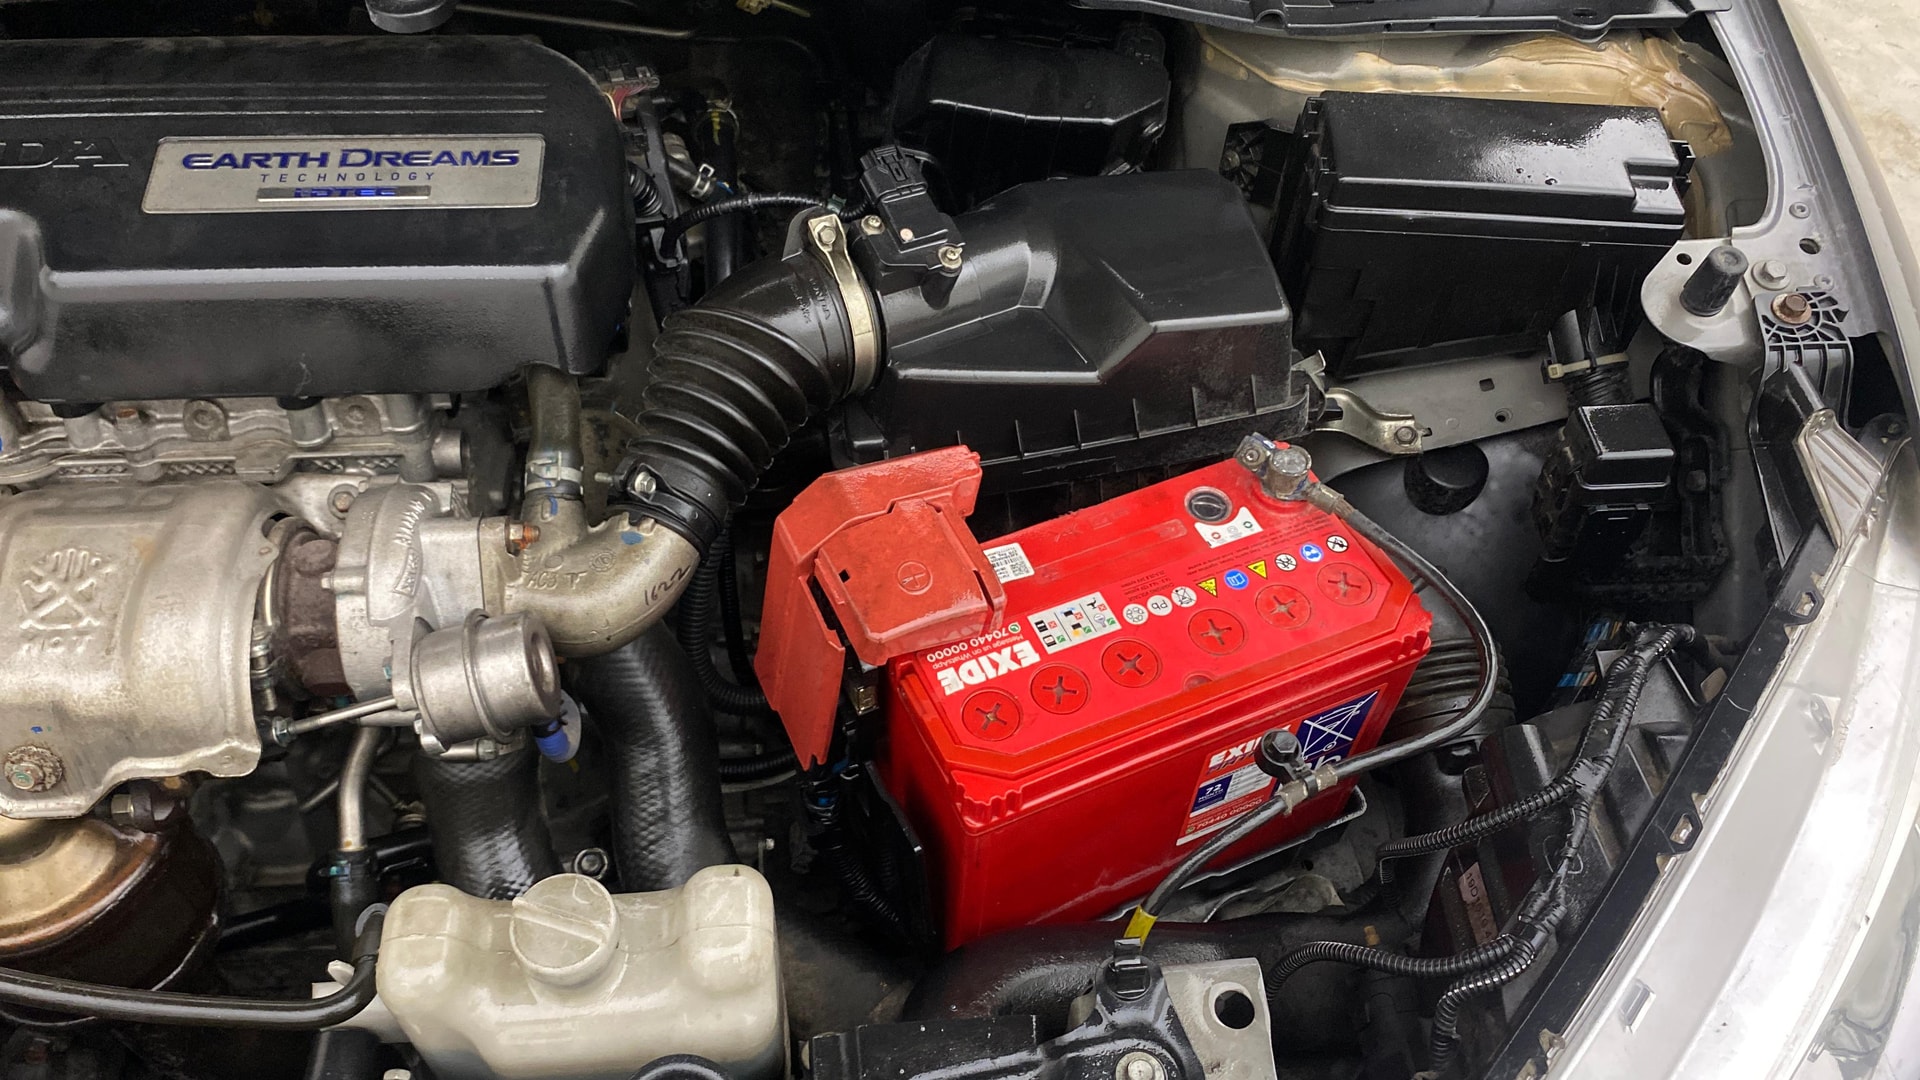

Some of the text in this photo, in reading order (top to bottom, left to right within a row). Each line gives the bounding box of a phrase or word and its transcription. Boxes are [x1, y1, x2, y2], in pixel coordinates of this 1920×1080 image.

[182, 147, 520, 170] EARTH DREAMS
[260, 171, 435, 184] TECHNOLOGY
[1151, 599, 1168, 610] Pb
[926, 627, 1009, 663] 70440 00000
[932, 652, 973, 670] WhatsApp
[936, 639, 1041, 697] EXIDE
[1205, 783, 1222, 796] 72
